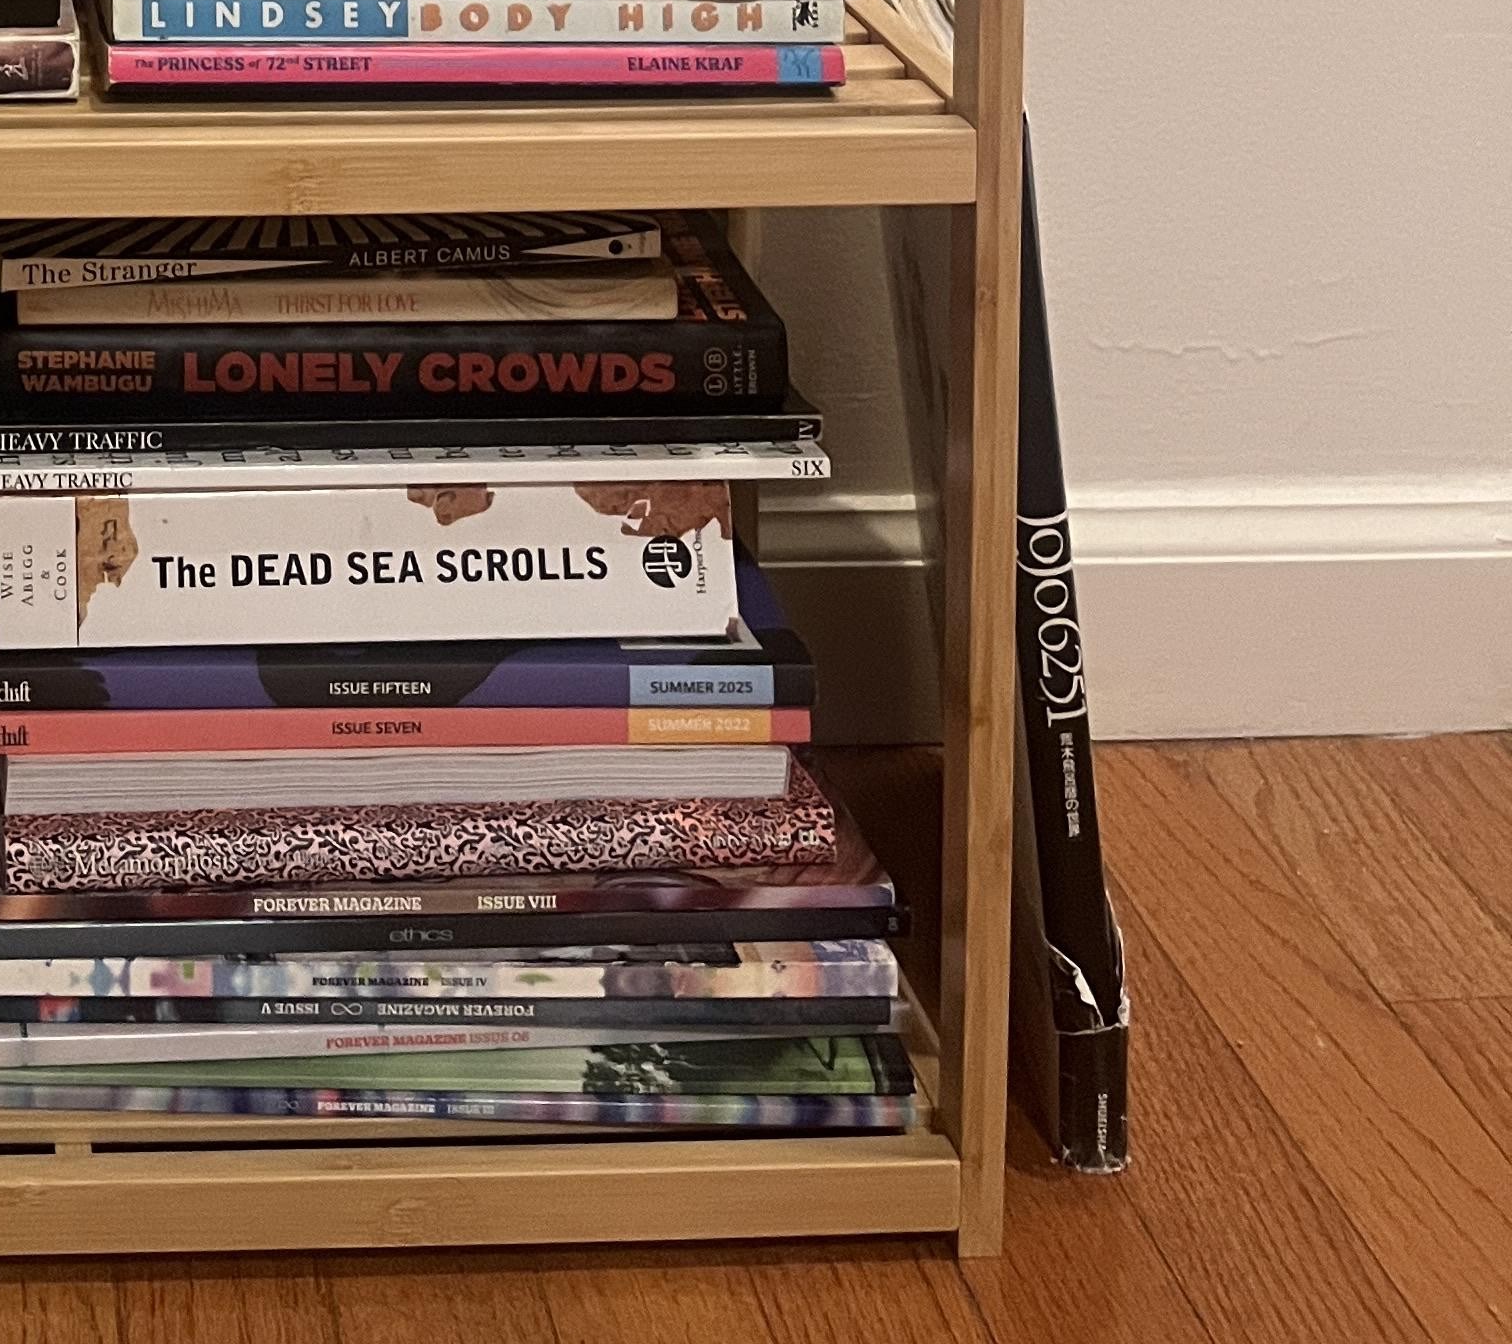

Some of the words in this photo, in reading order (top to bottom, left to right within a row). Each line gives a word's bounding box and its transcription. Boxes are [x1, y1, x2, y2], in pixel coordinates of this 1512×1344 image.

[68, 429, 162, 449] TRAFFIC
[791, 460, 824, 477] SIX
[153, 553, 216, 589] The
[231, 554, 331, 587] DEAD
[347, 552, 423, 584] SEA
[437, 547, 608, 582] SCROLLS
[329, 680, 371, 695] ISSUE
[373, 680, 431, 695] FIFTEEN
[649, 680, 717, 694] SUMMER
[720, 680, 753, 694] 2025
[331, 721, 372, 735] ISSUE
[375, 721, 421, 735] SEVEN
[253, 898, 329, 913] FOREVER
[334, 897, 422, 911] MAGAZINE
[478, 895, 524, 910] ISSUE
[528, 895, 557, 909] VIII
